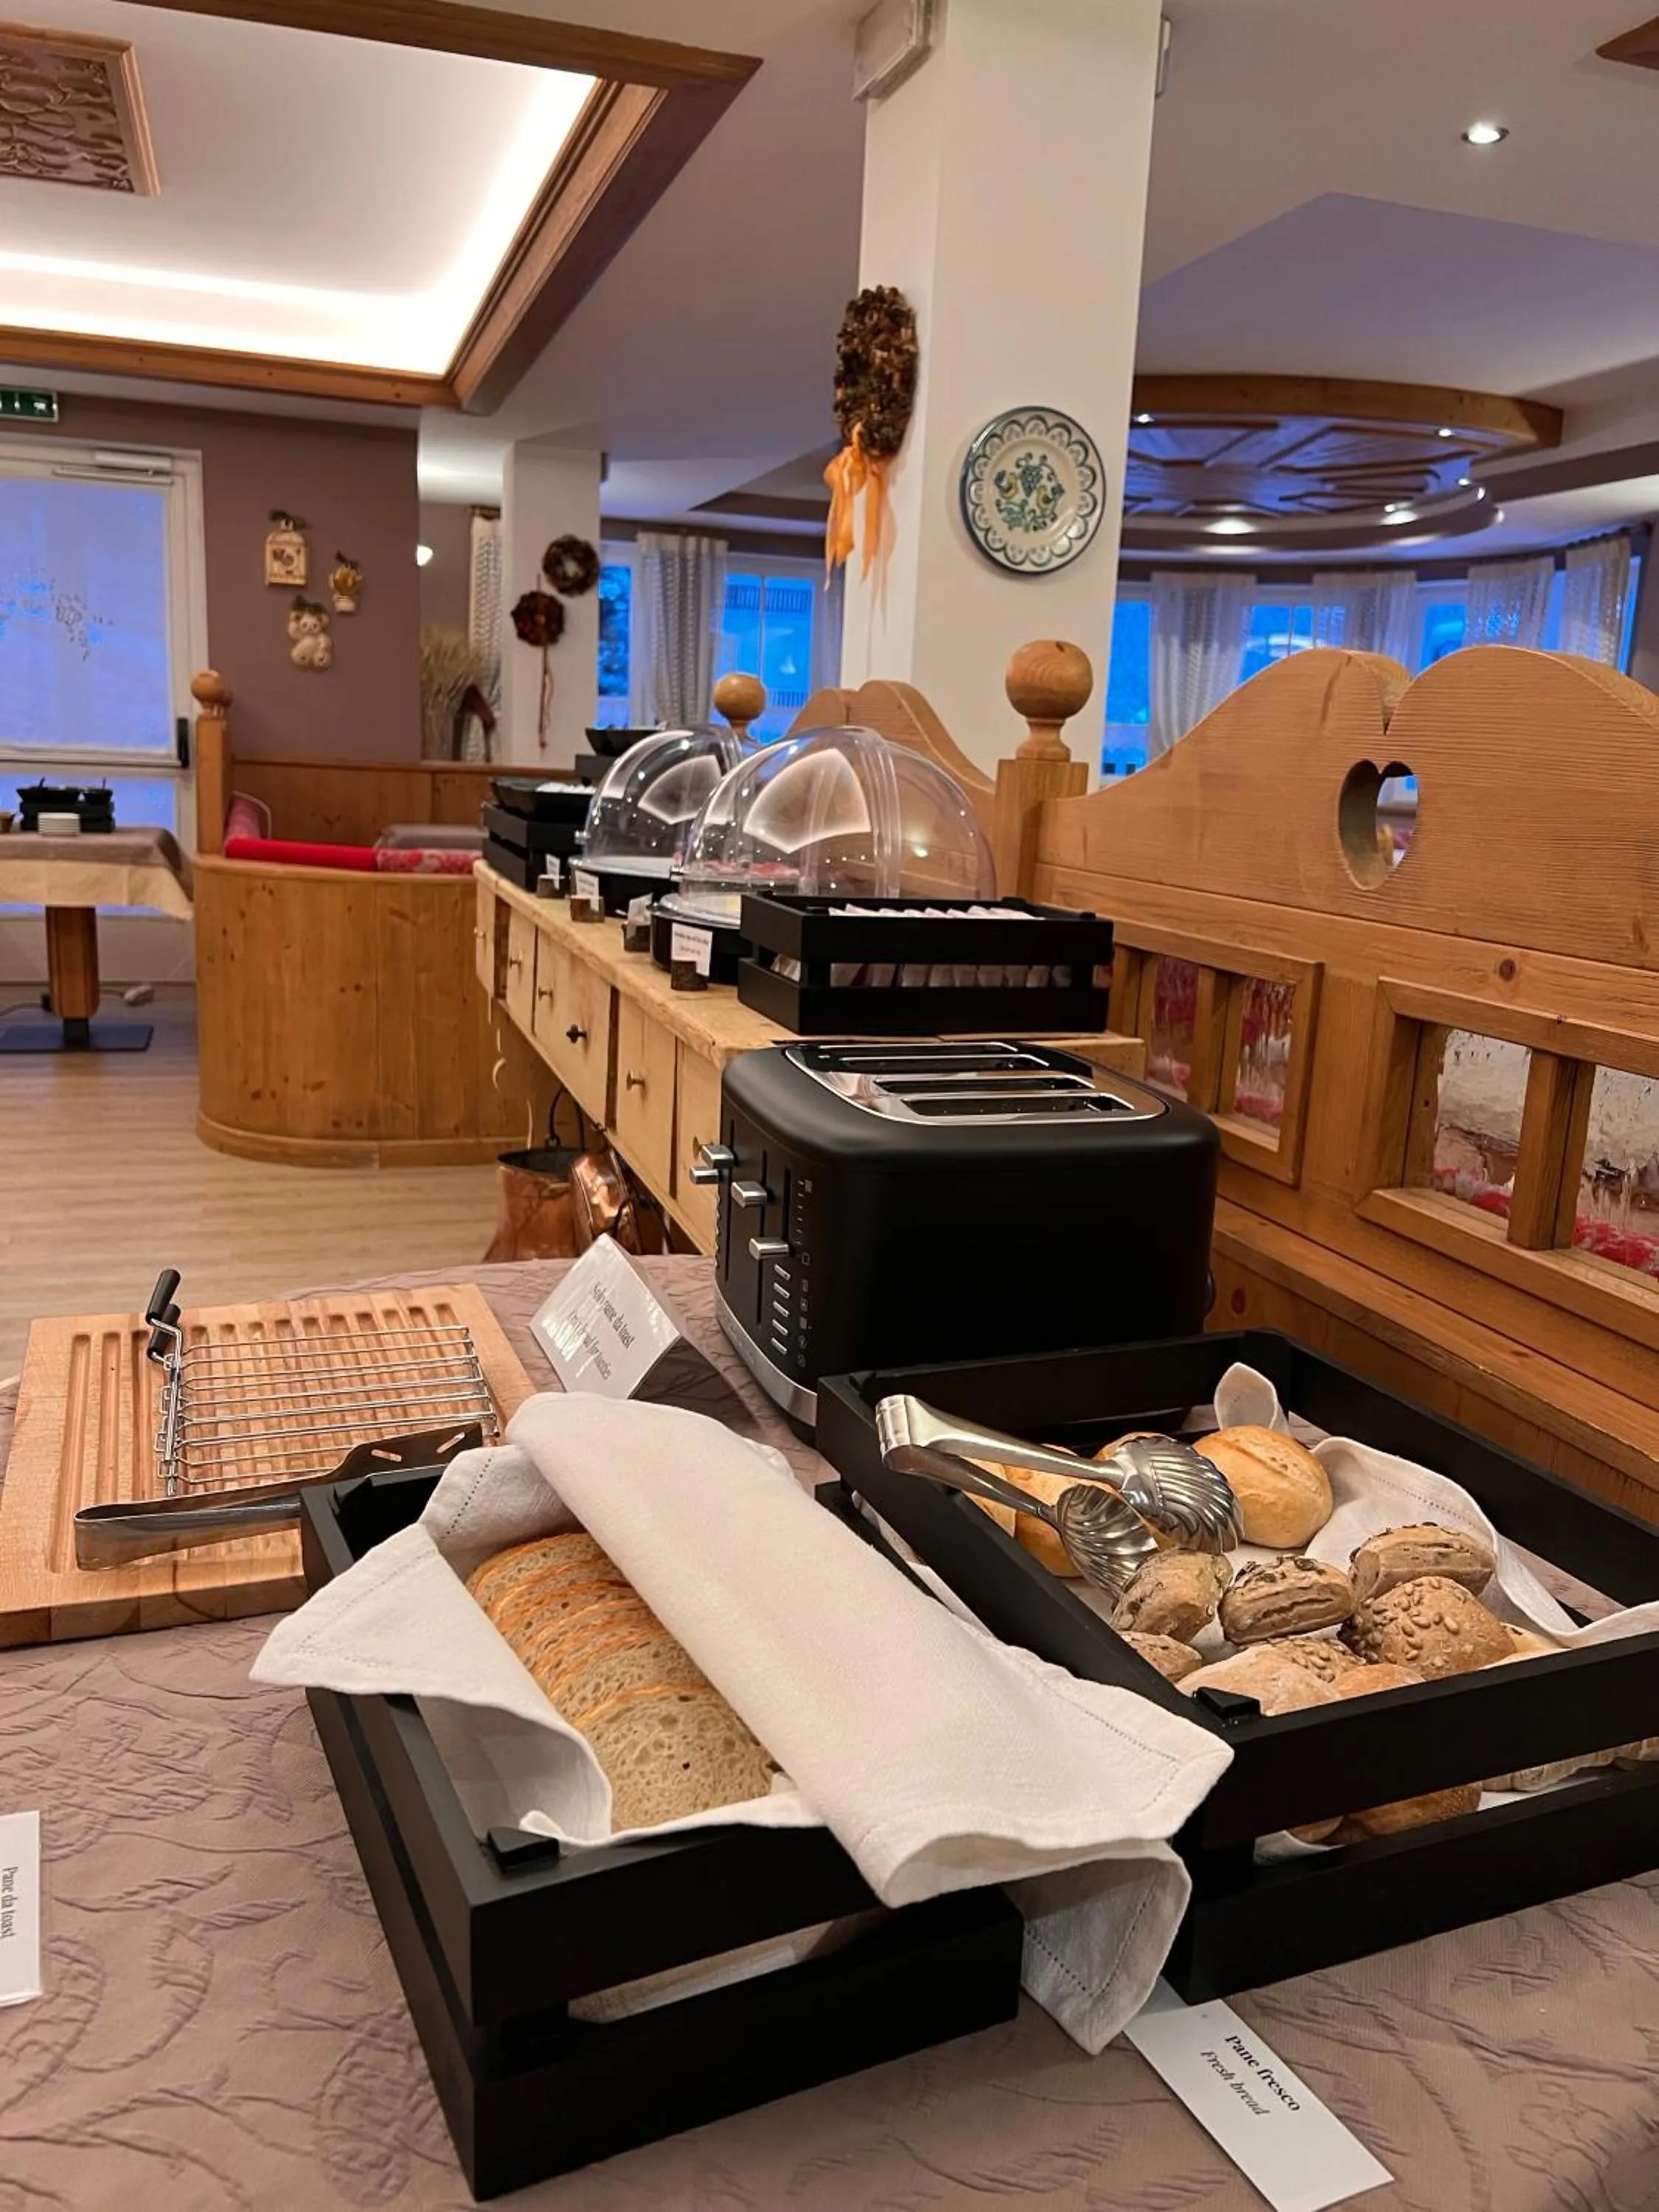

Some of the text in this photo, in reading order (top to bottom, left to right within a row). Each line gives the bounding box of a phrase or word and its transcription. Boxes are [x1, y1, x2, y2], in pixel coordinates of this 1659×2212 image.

[0, 1865, 18, 1940] Pane da toast
[1200, 2051, 1270, 2115] Fresh bread
[1225, 2035, 1301, 2111] Pane fresco
